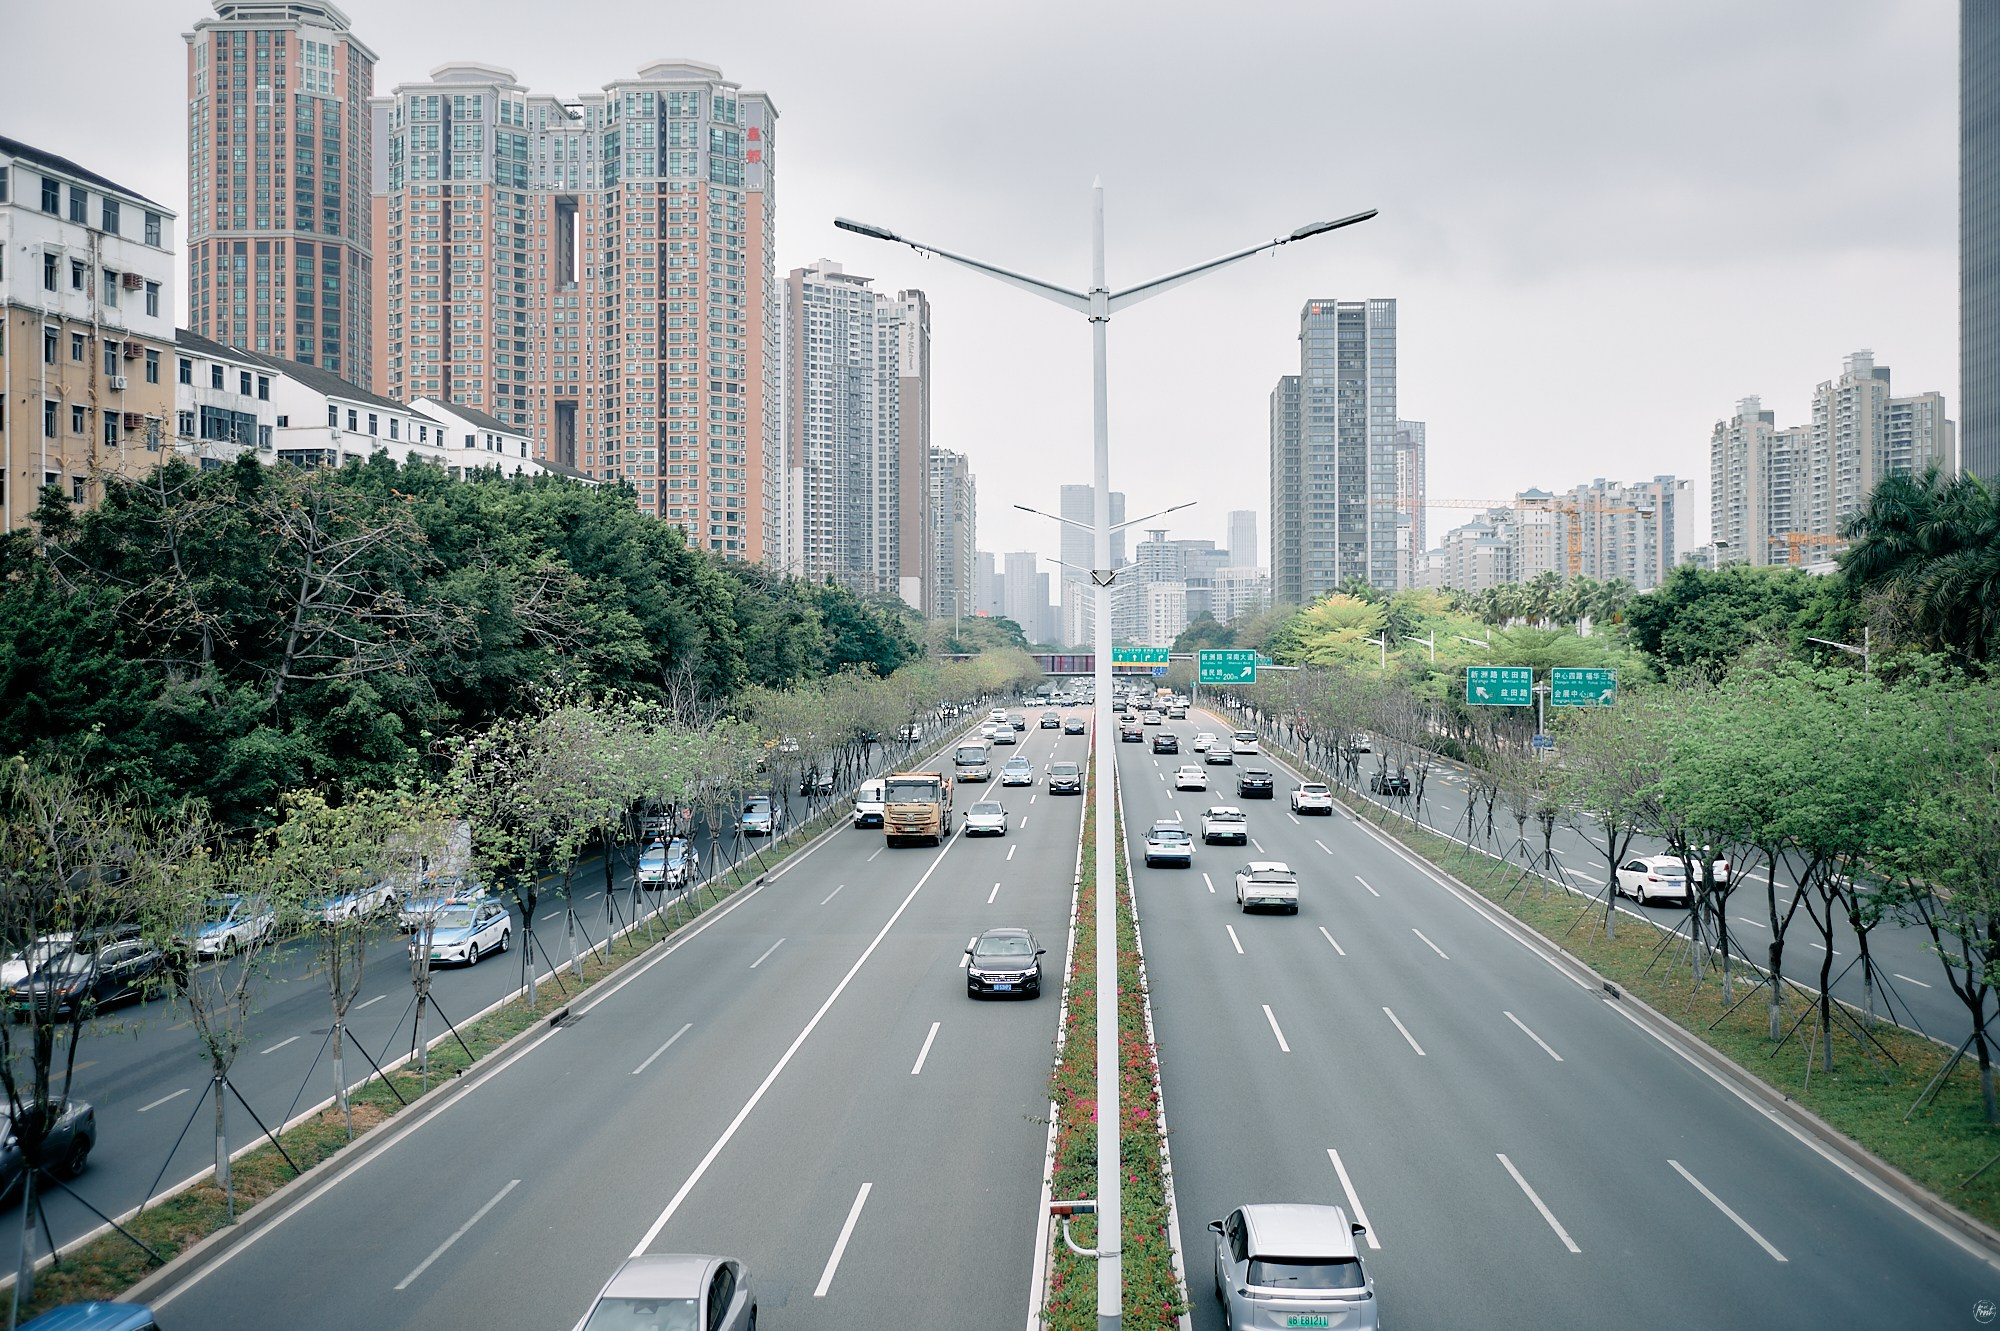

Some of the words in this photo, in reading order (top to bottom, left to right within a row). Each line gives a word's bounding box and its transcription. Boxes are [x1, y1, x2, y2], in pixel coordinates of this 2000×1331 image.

[1226, 653, 1254, 661] 深南大道
[1223, 673, 1239, 681] 200m
[1470, 670, 1498, 679] 新洲路
[1501, 670, 1528, 679] 民田路
[1554, 672, 1583, 680] 中心四路
[1500, 688, 1528, 697] 益田路
